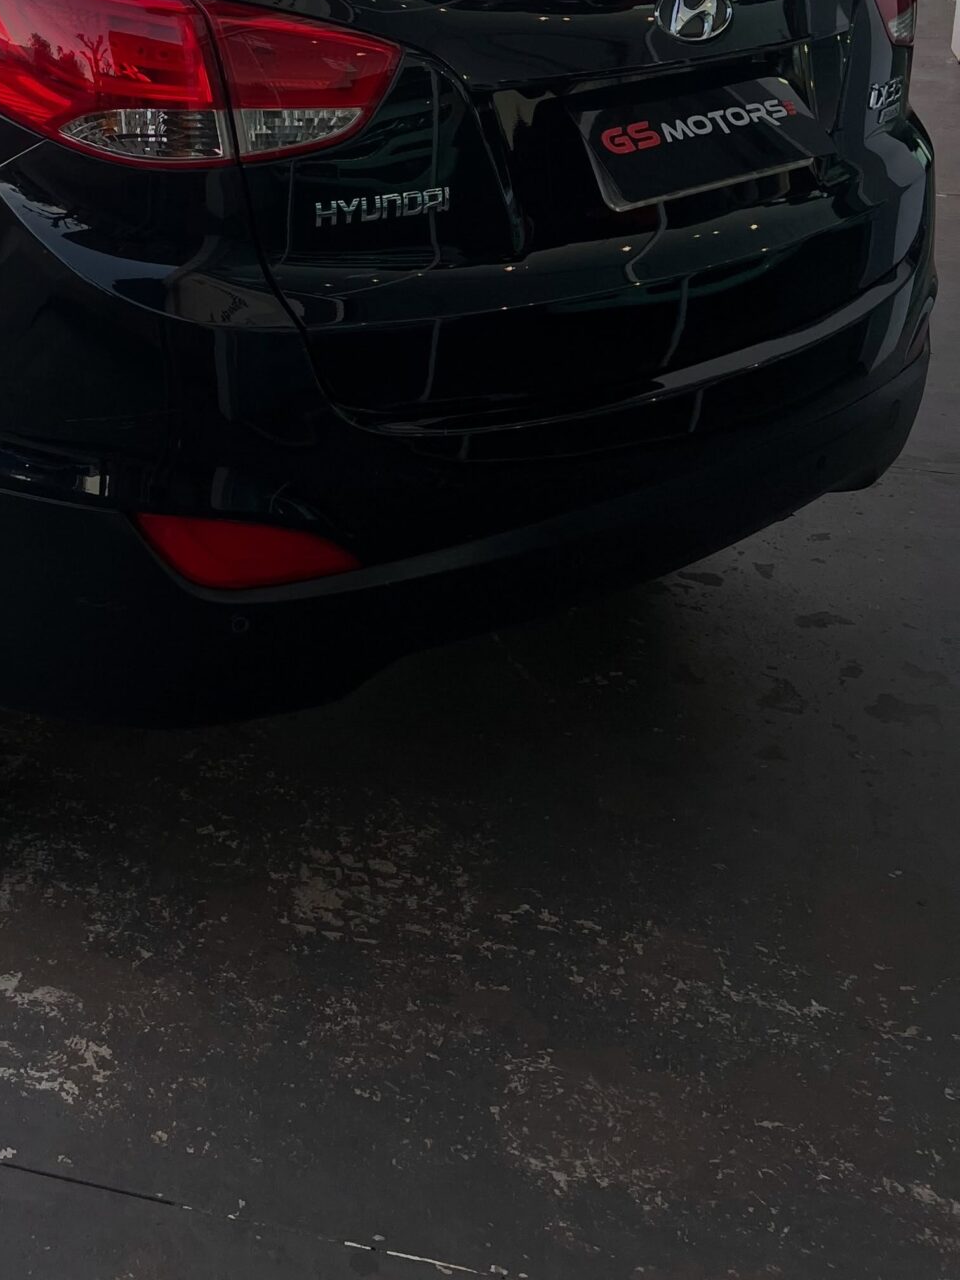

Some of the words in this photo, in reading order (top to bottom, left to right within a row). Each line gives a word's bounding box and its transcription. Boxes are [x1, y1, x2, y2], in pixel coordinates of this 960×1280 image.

[600, 119, 663, 156] GS
[660, 98, 788, 143] MOTORS
[315, 186, 451, 228] HYUNDAI
